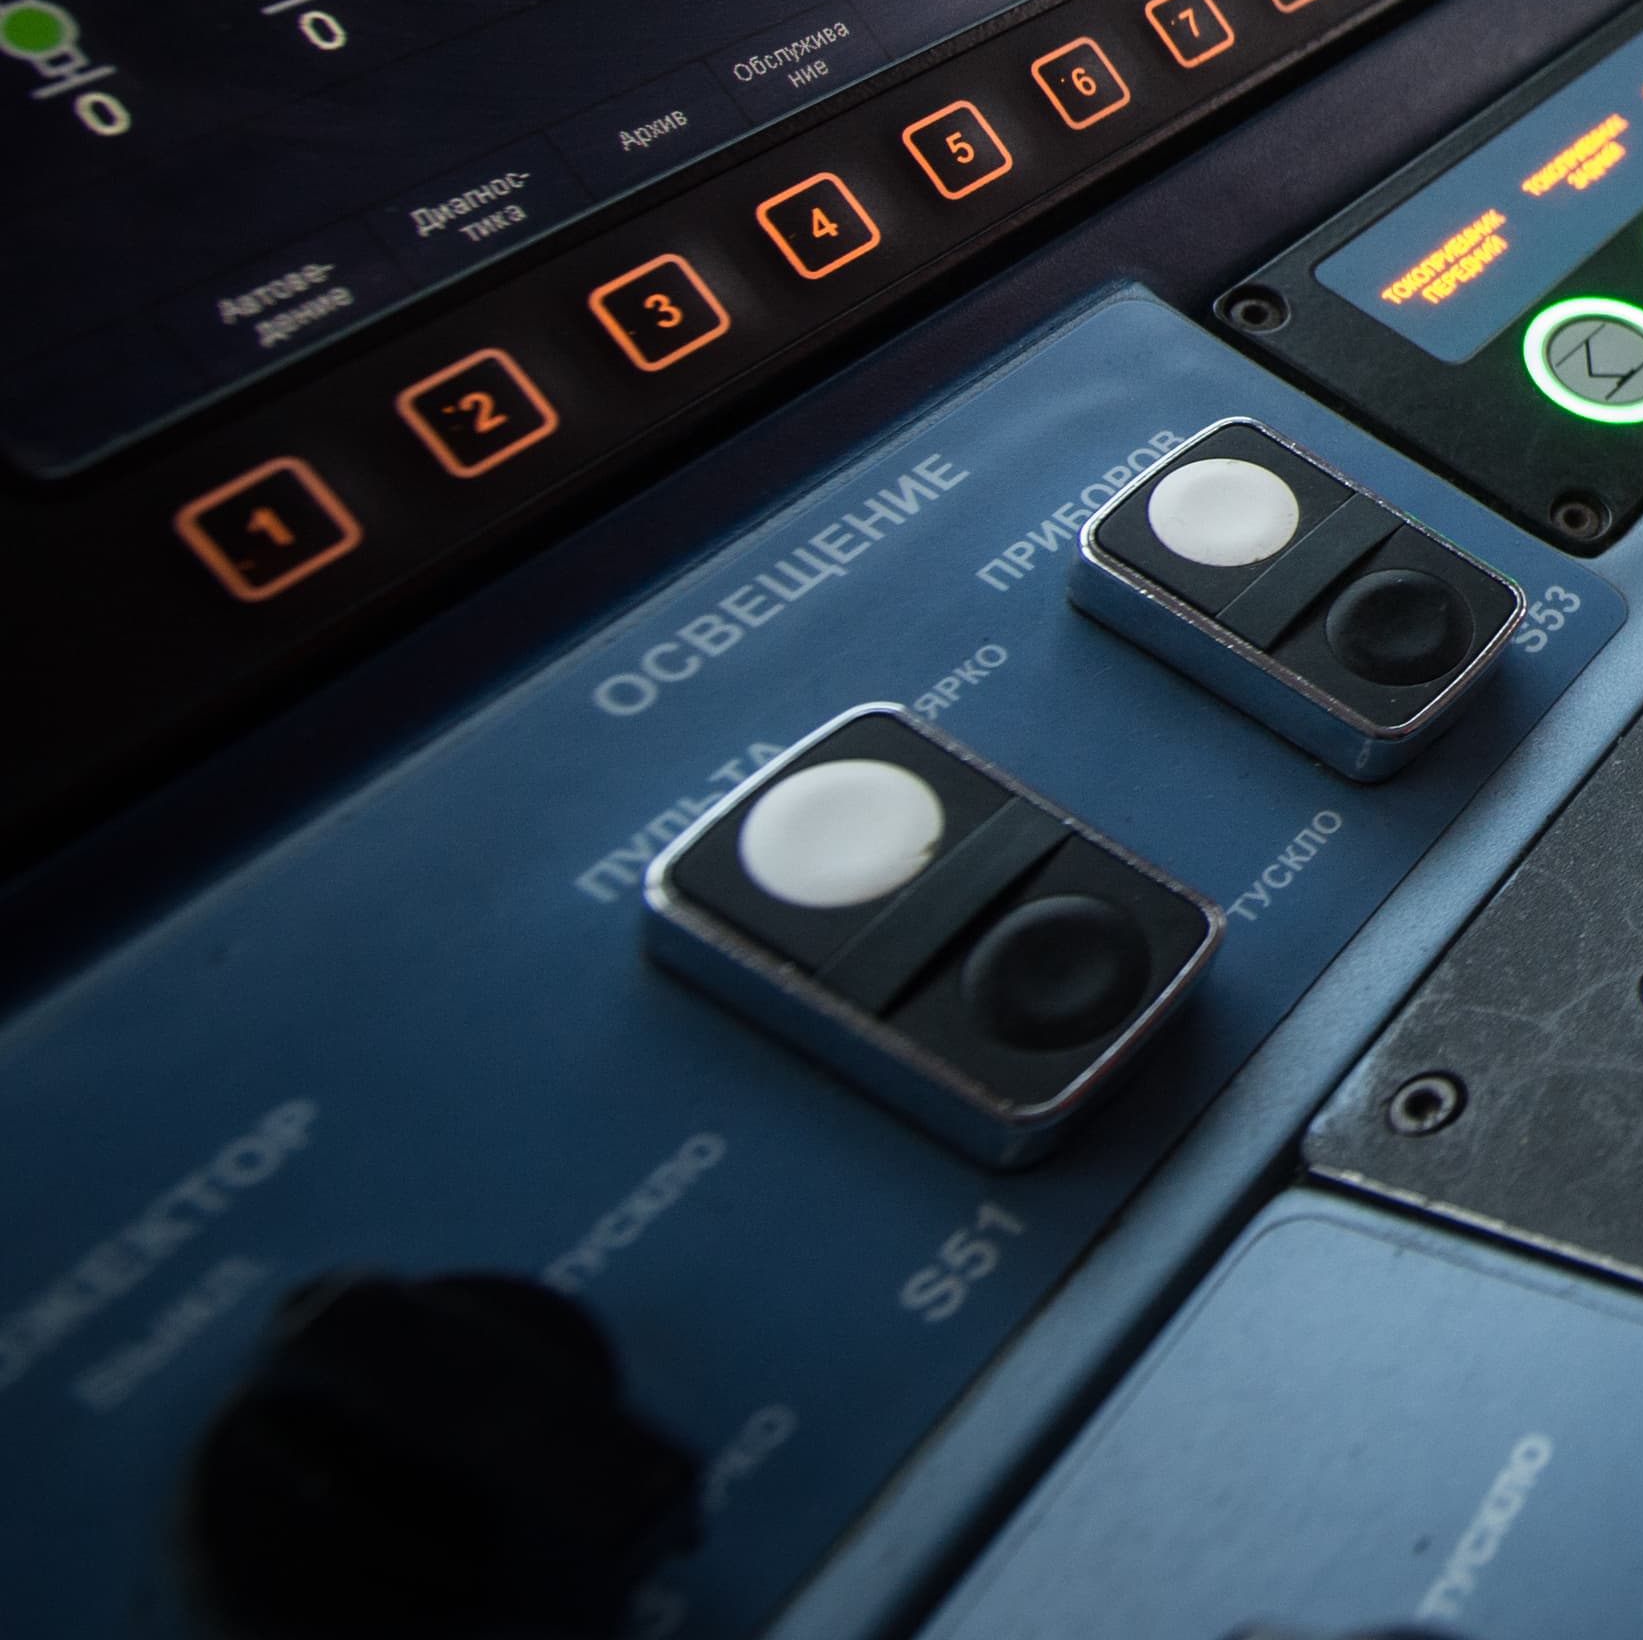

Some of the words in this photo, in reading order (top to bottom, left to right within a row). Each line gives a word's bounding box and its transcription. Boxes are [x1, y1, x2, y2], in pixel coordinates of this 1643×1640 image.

[298, 9, 347, 51] 0
[1177, 7, 1201, 39] 7
[732, 20, 851, 84] Обслужива
[787, 57, 830, 89] ние
[1070, 66, 1098, 97] 6
[73, 90, 132, 137] 0
[617, 107, 690, 153] Архив
[944, 131, 976, 165] 5
[409, 168, 532, 238] Диагнос-
[458, 200, 529, 245] тика
[809, 207, 840, 241] 4
[641, 292, 685, 329] 3
[457, 390, 510, 434] 2
[246, 505, 297, 549] 1
[975, 429, 1187, 593] ПРИБОРОВ
[592, 452, 972, 717] ОСВЕЩЕНИЕ
[1509, 584, 1581, 654] S53
[913, 644, 1008, 721] ЯРКО
[1226, 807, 1345, 924] ТУСКЛО
[901, 1200, 1026, 1322] S51
